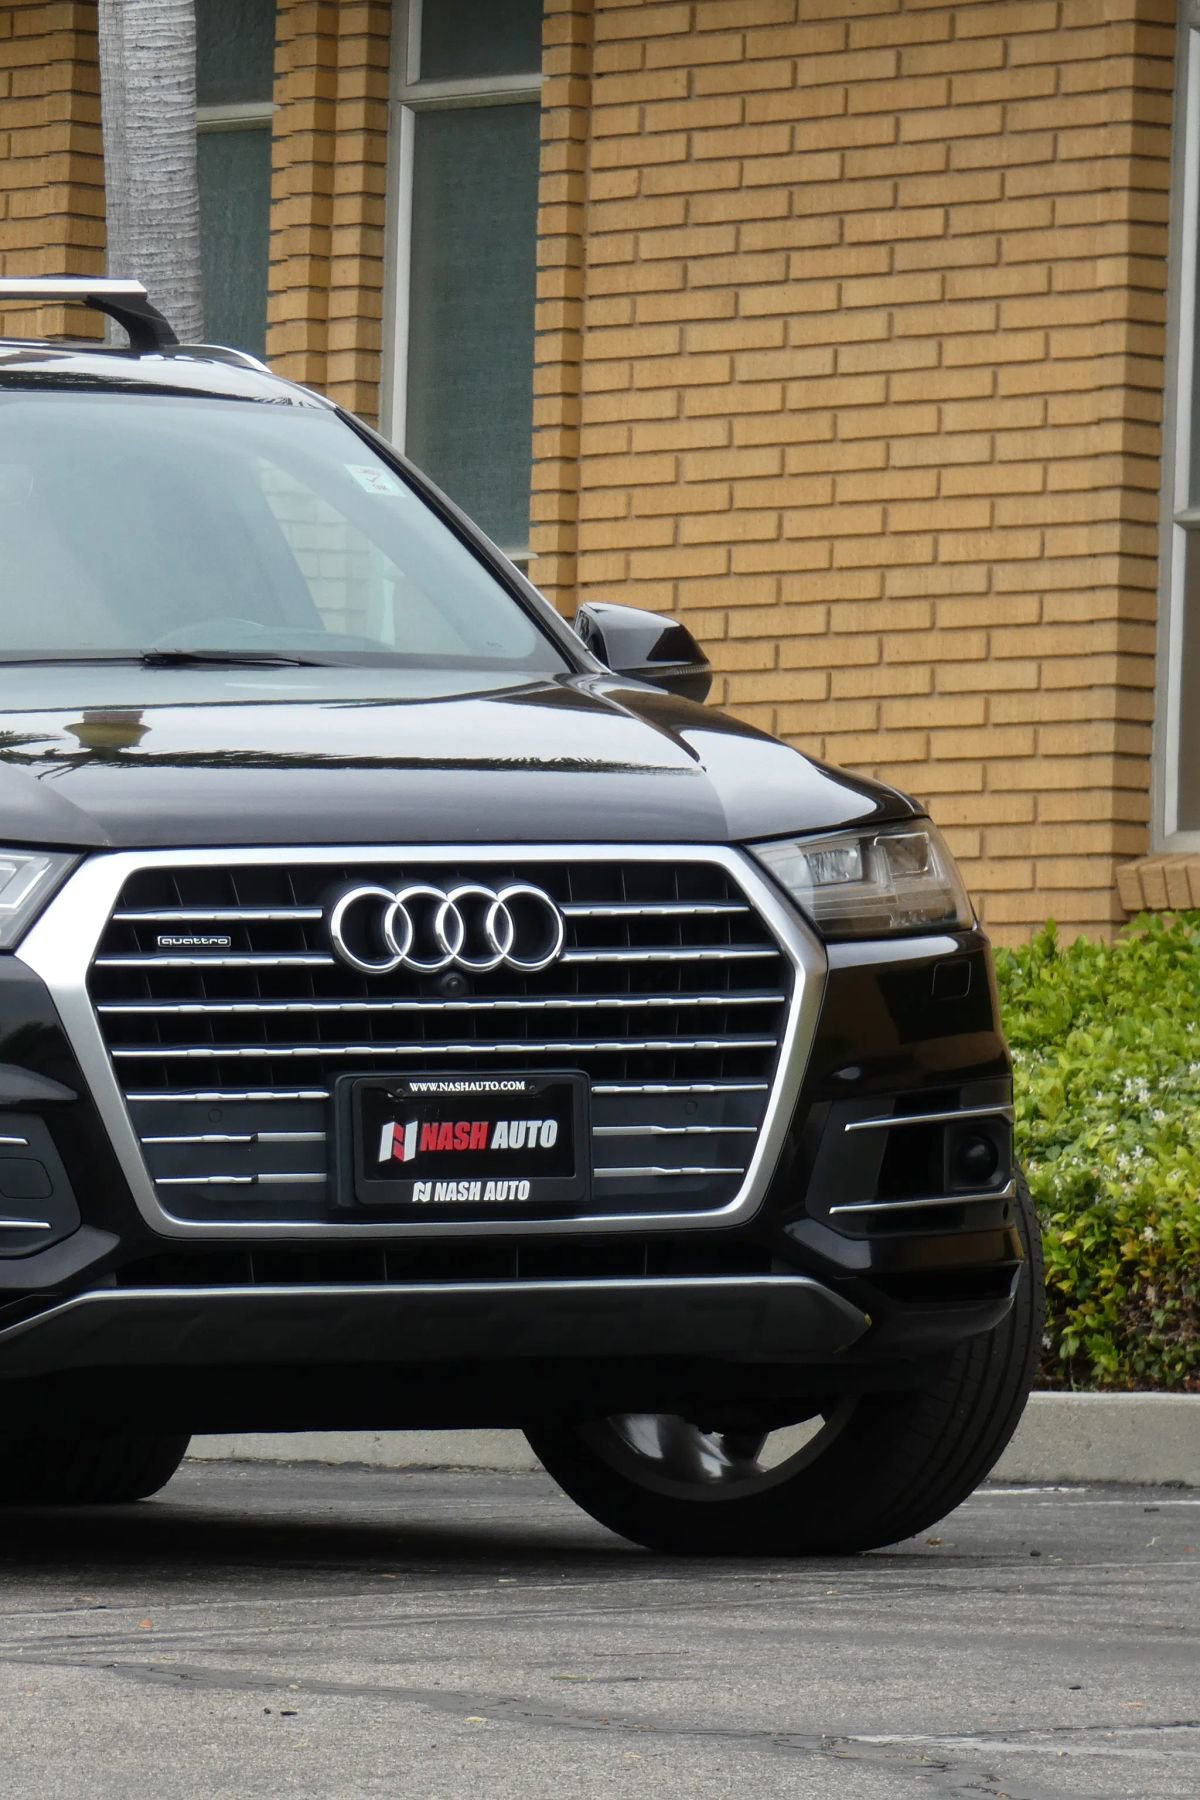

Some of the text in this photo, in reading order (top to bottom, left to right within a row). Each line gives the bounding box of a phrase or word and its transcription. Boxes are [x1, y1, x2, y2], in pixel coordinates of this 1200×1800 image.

[161, 937, 228, 946] quattro
[409, 1081, 525, 1092] WWW.NASHAUTO.COM
[419, 1121, 490, 1151] NASH
[490, 1119, 558, 1149] AUTO
[434, 1181, 482, 1201] NASH
[484, 1180, 530, 1200] AUTO
